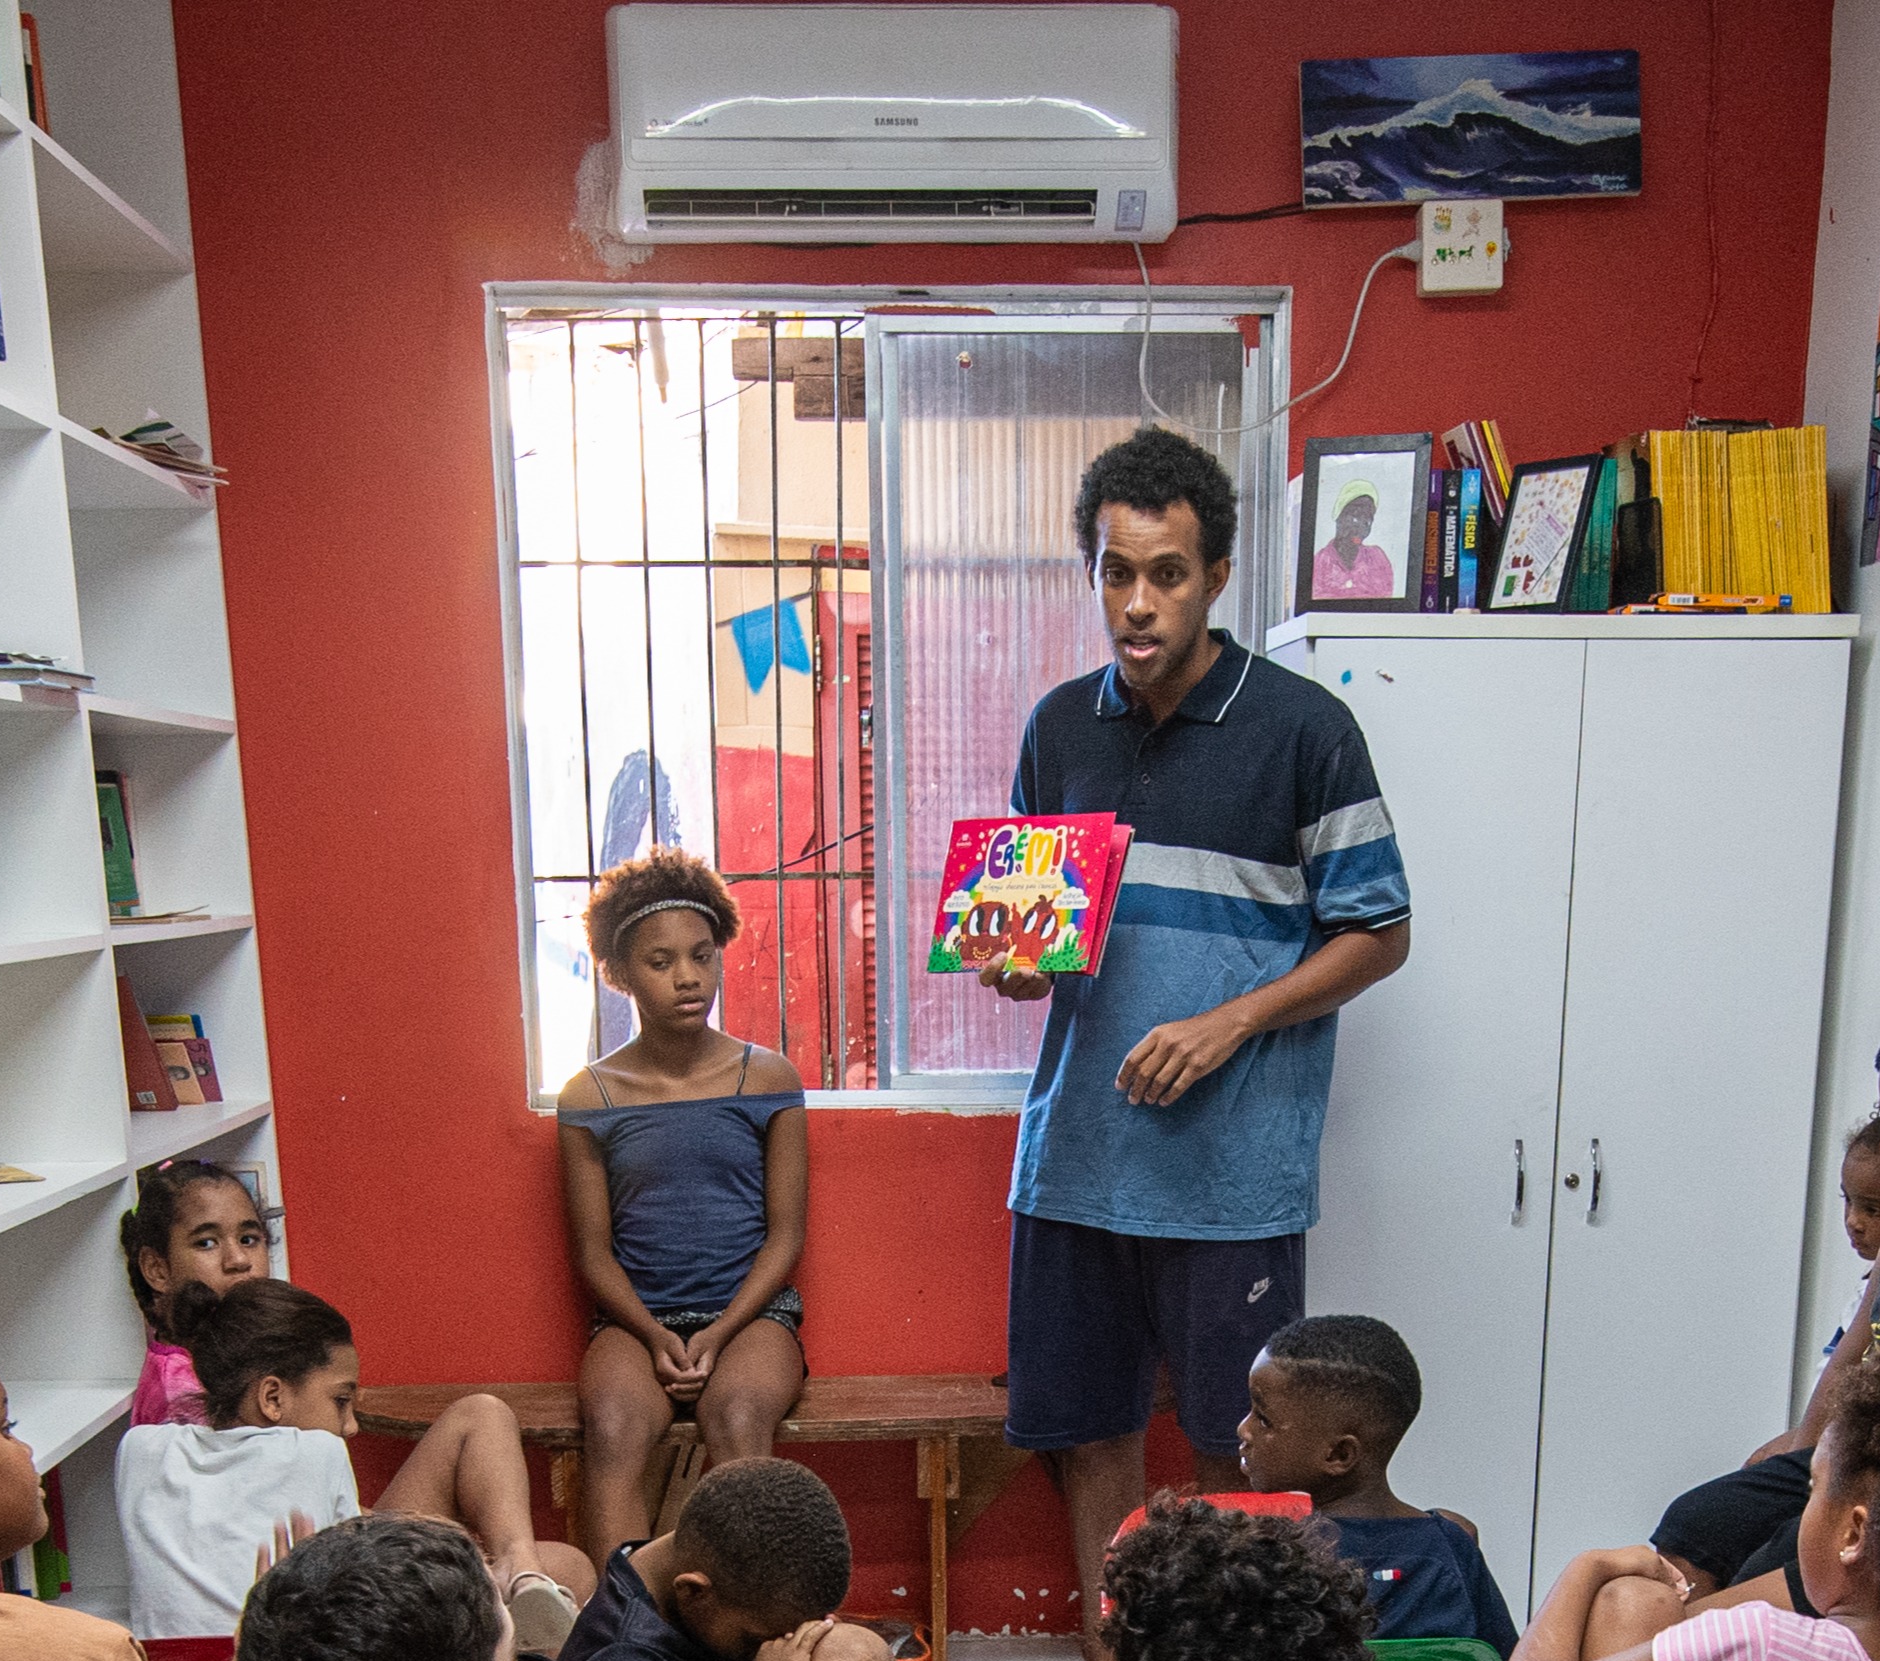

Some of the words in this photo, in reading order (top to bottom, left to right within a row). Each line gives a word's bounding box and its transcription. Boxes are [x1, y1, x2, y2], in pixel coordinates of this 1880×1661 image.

[873, 116, 920, 127] SAMSUNG
[1425, 510, 1439, 574] FEMINISMO
[1444, 515, 1457, 578] MATEMÁTICA
